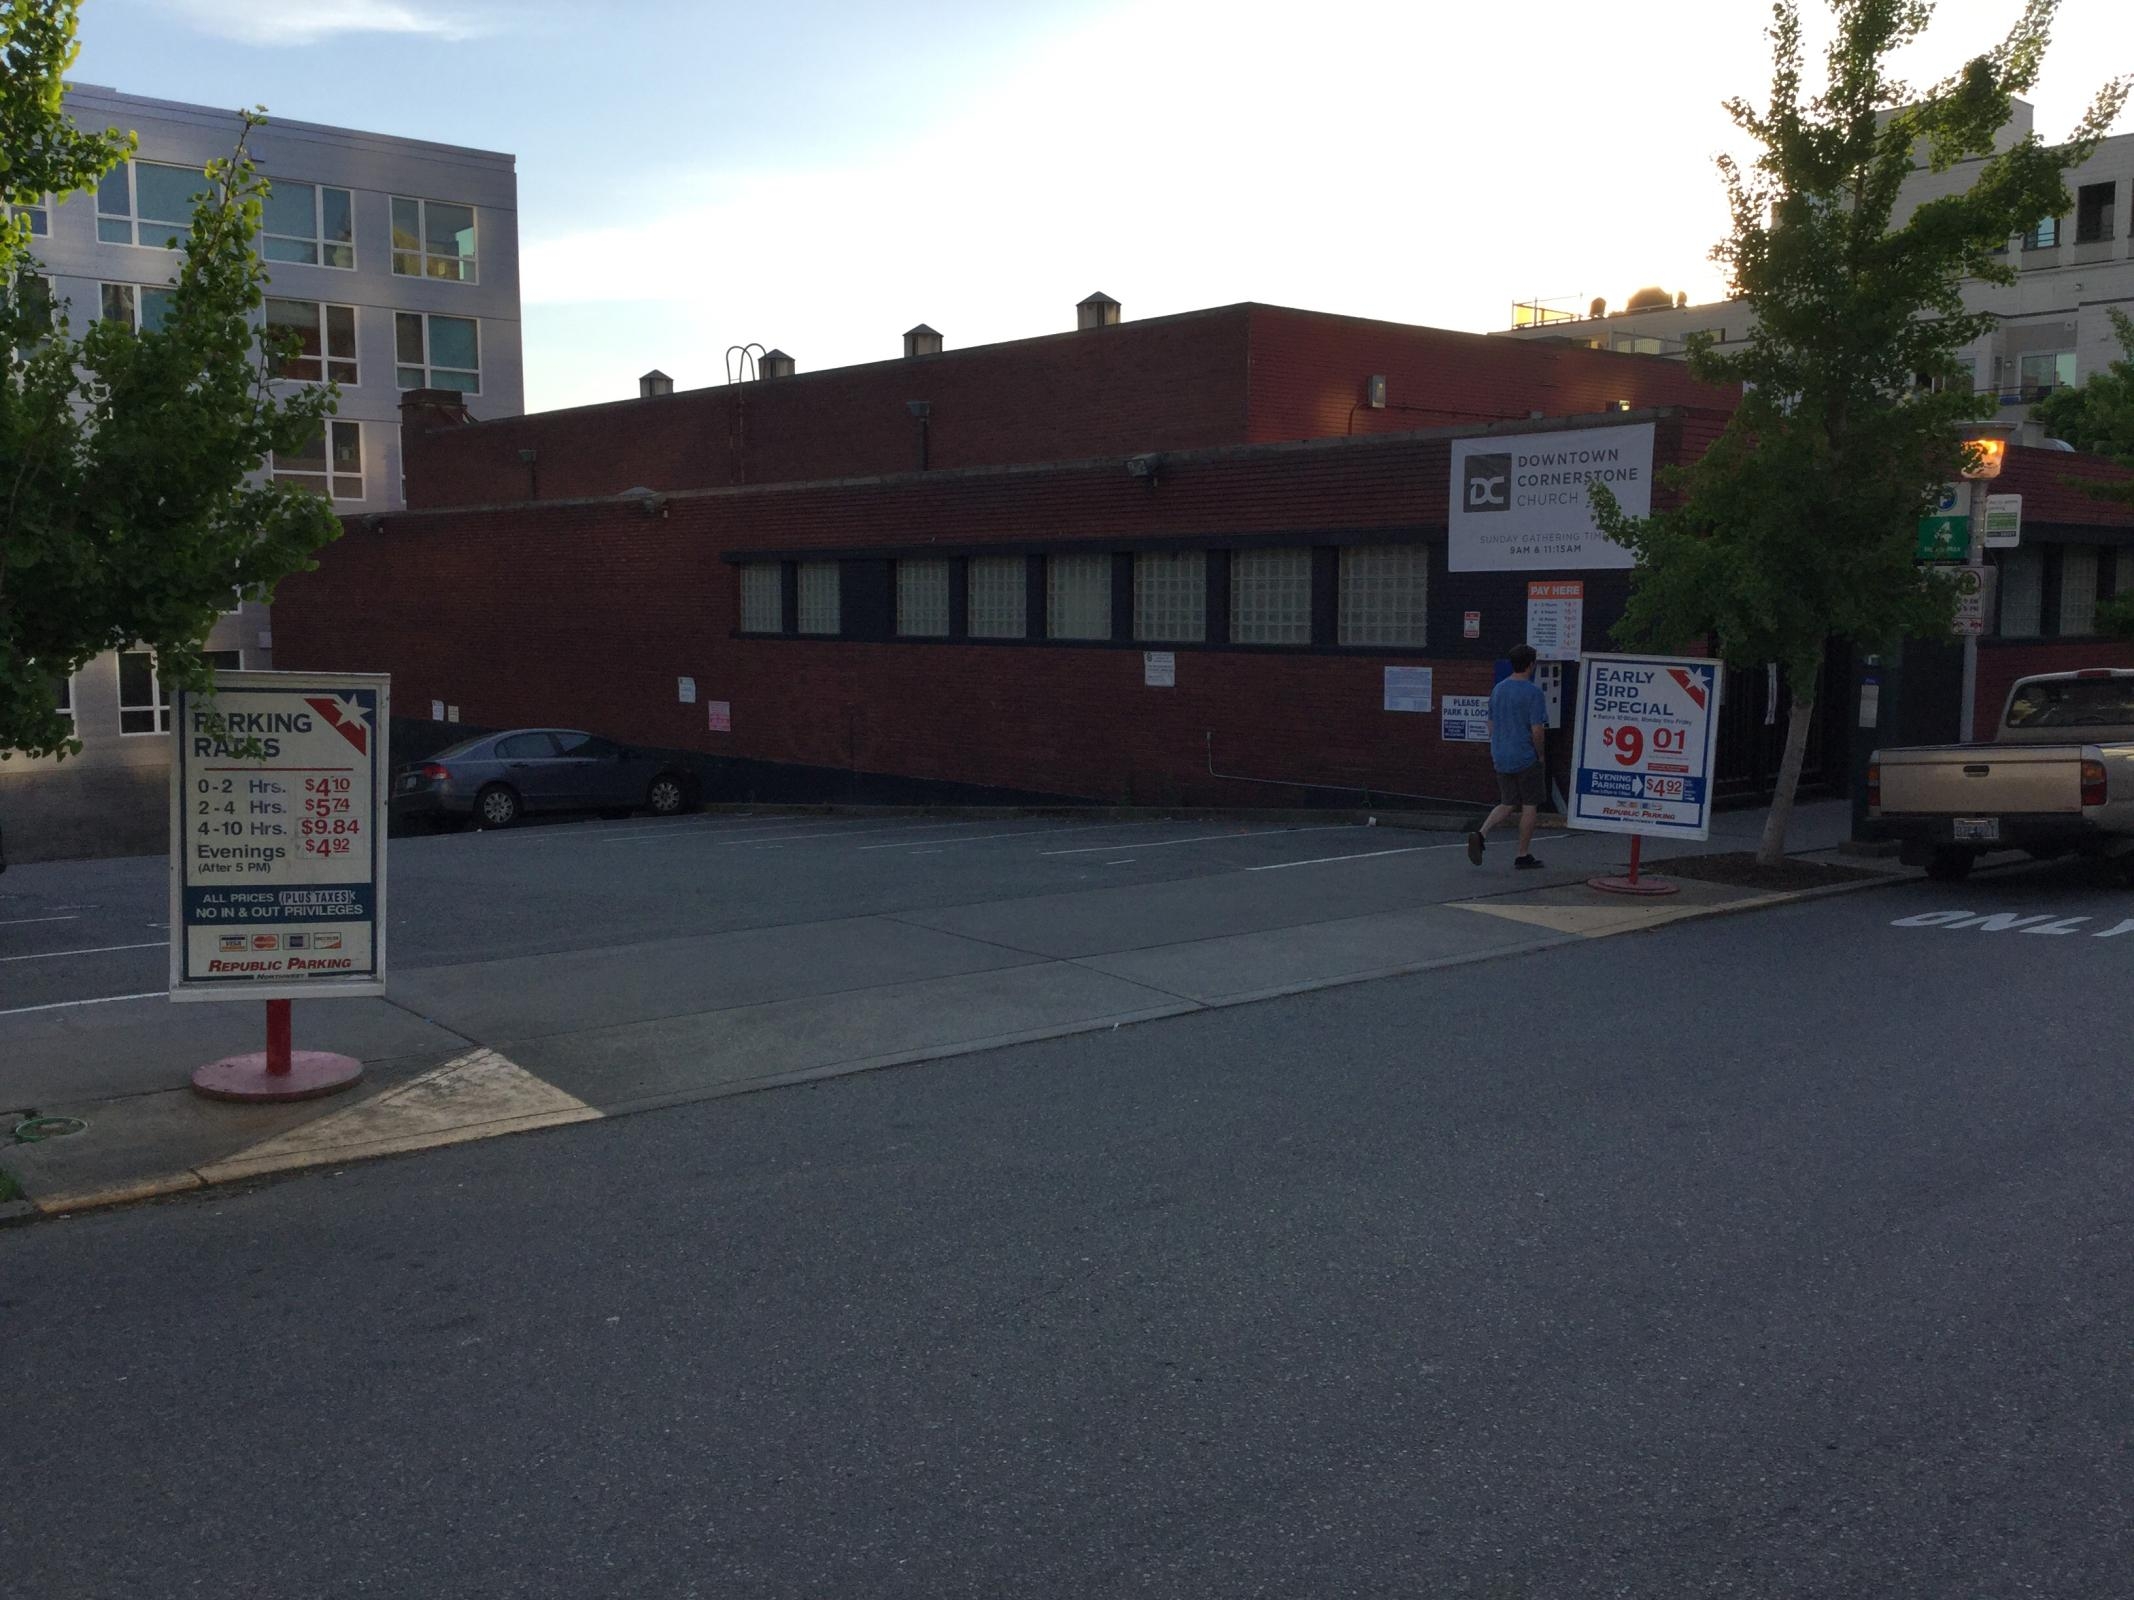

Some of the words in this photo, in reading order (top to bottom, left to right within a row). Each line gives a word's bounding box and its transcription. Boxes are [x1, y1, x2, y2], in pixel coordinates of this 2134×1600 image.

[1518, 449, 1618, 467] DOWNTOWN
[1517, 468, 1638, 487] CORNERSTONE
[1517, 492, 1578, 507] CHURCH
[1480, 535, 1518, 544] SUNDAY
[1522, 533, 1580, 543] GATHERING
[1510, 546, 1530, 554] 9AM
[1544, 545, 1582, 554] 11:15AM
[1531, 586, 1550, 595] PAY
[1552, 586, 1581, 595] HERE
[1596, 668, 1655, 684] EARLY
[1595, 683, 1639, 698] BIRD
[1453, 698, 1480, 707] PLEASE
[1594, 698, 1674, 716] SPECIAL
[1443, 708, 1462, 716] PARK
[1591, 771, 1632, 783] EVENING
[249, 779, 286, 793] Hrs.
[1591, 780, 1631, 791] PARKING
[250, 800, 287, 814] Hrs.
[1602, 807, 1640, 818] REPUBLIC
[1642, 810, 1676, 820] PARKING
[250, 822, 287, 835] Hrs.
[301, 818, 360, 837] $9.84
[198, 844, 285, 861] Evenings
[198, 862, 231, 874] (After
[235, 863, 243, 872] 5
[248, 862, 271, 873] PM)
[203, 893, 226, 903] ALL
[230, 893, 274, 902] PRICES
[196, 907, 217, 918] NO
[221, 907, 235, 918] IN
[238, 907, 248, 917] &
[252, 906, 280, 917] OUT
[285, 904, 364, 917] PRIVILEGES
[208, 958, 282, 972] REPUBLIC
[287, 956, 352, 970] PARKING
